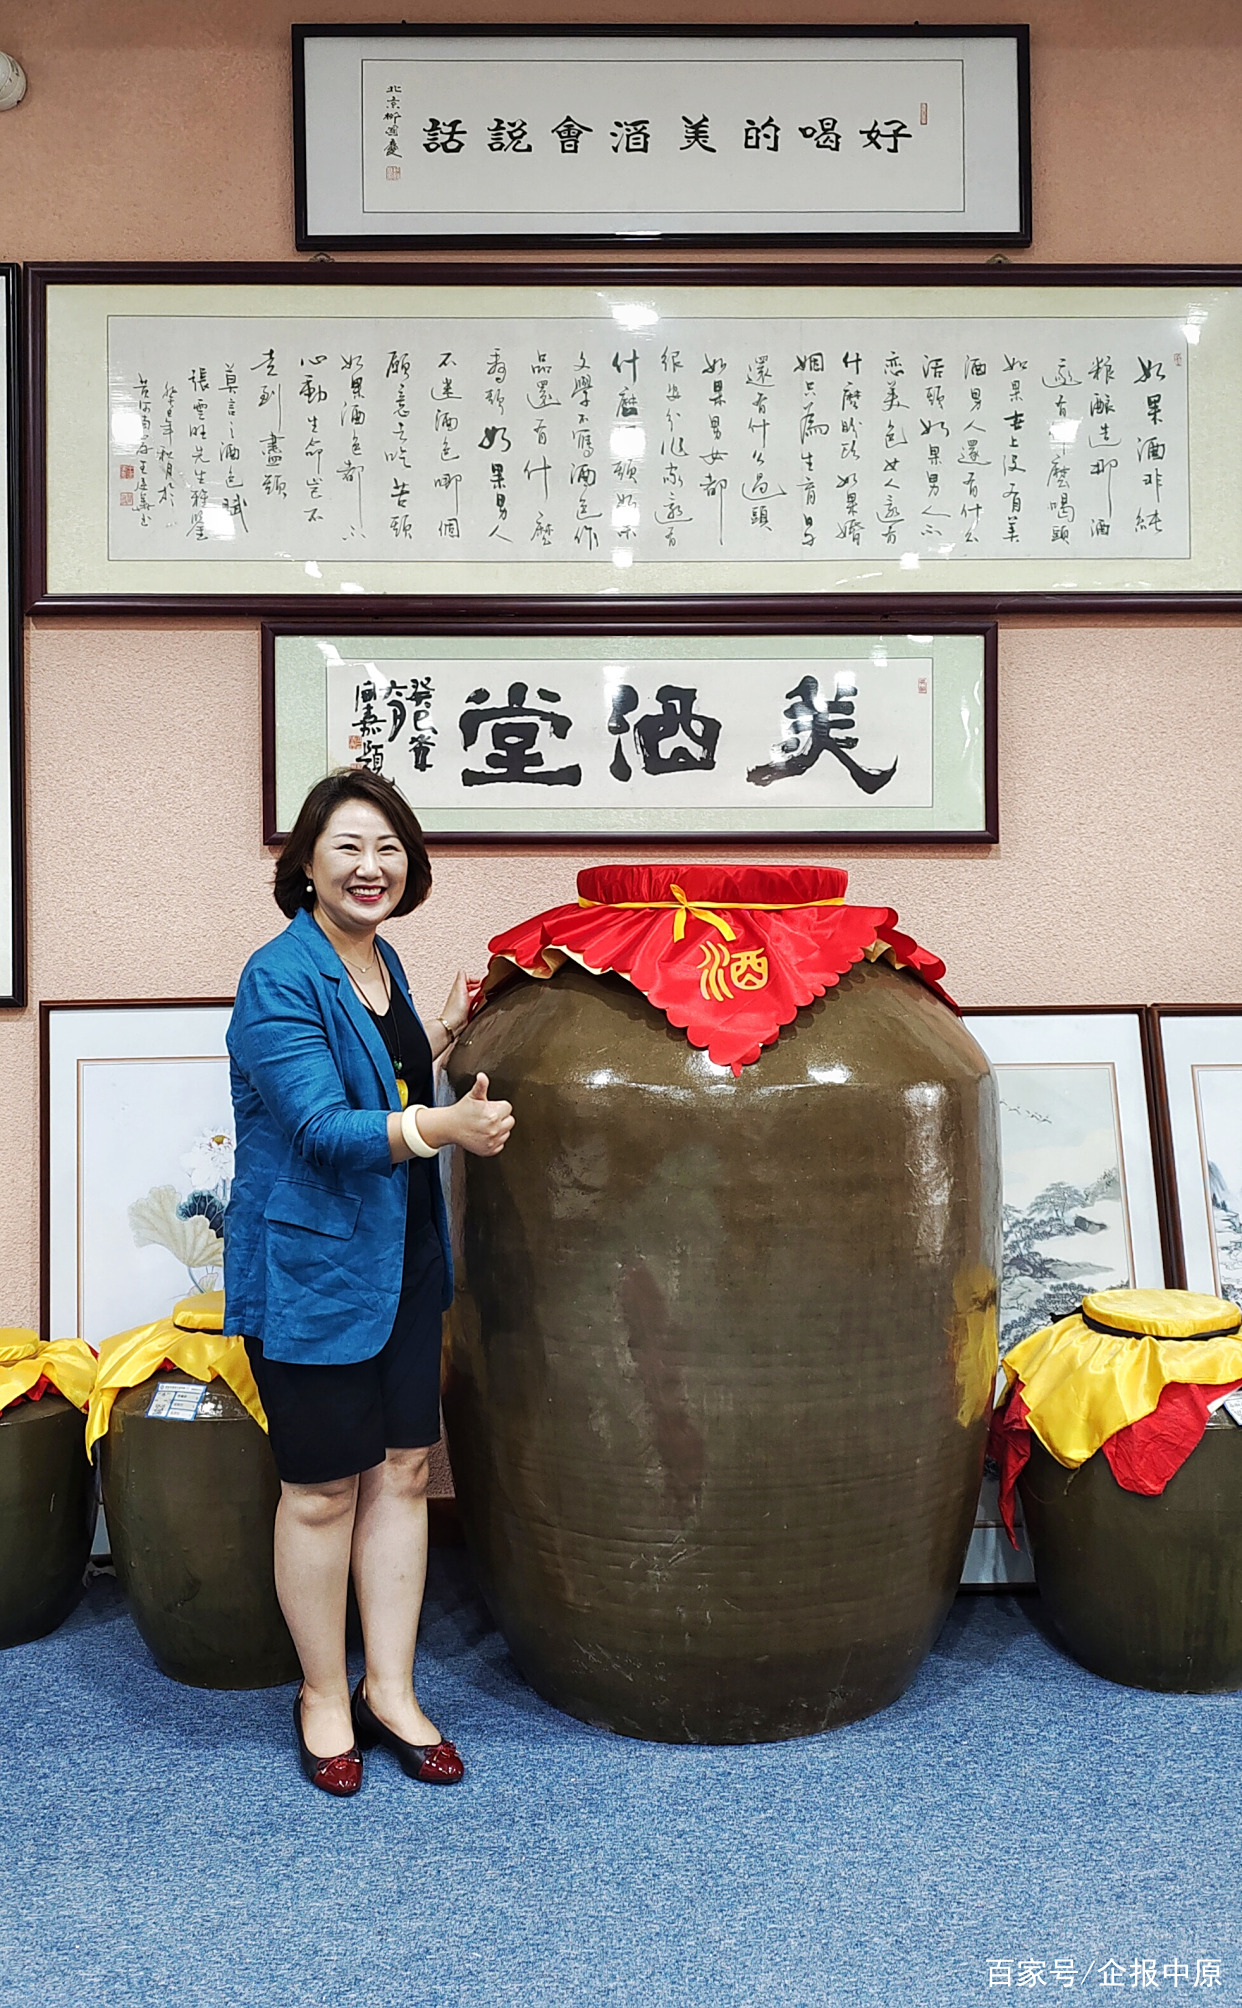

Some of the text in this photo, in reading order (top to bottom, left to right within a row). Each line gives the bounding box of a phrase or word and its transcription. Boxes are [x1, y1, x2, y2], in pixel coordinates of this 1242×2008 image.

[459, 675, 899, 795] 美酒堂
[697, 941, 769, 1002] 酒
